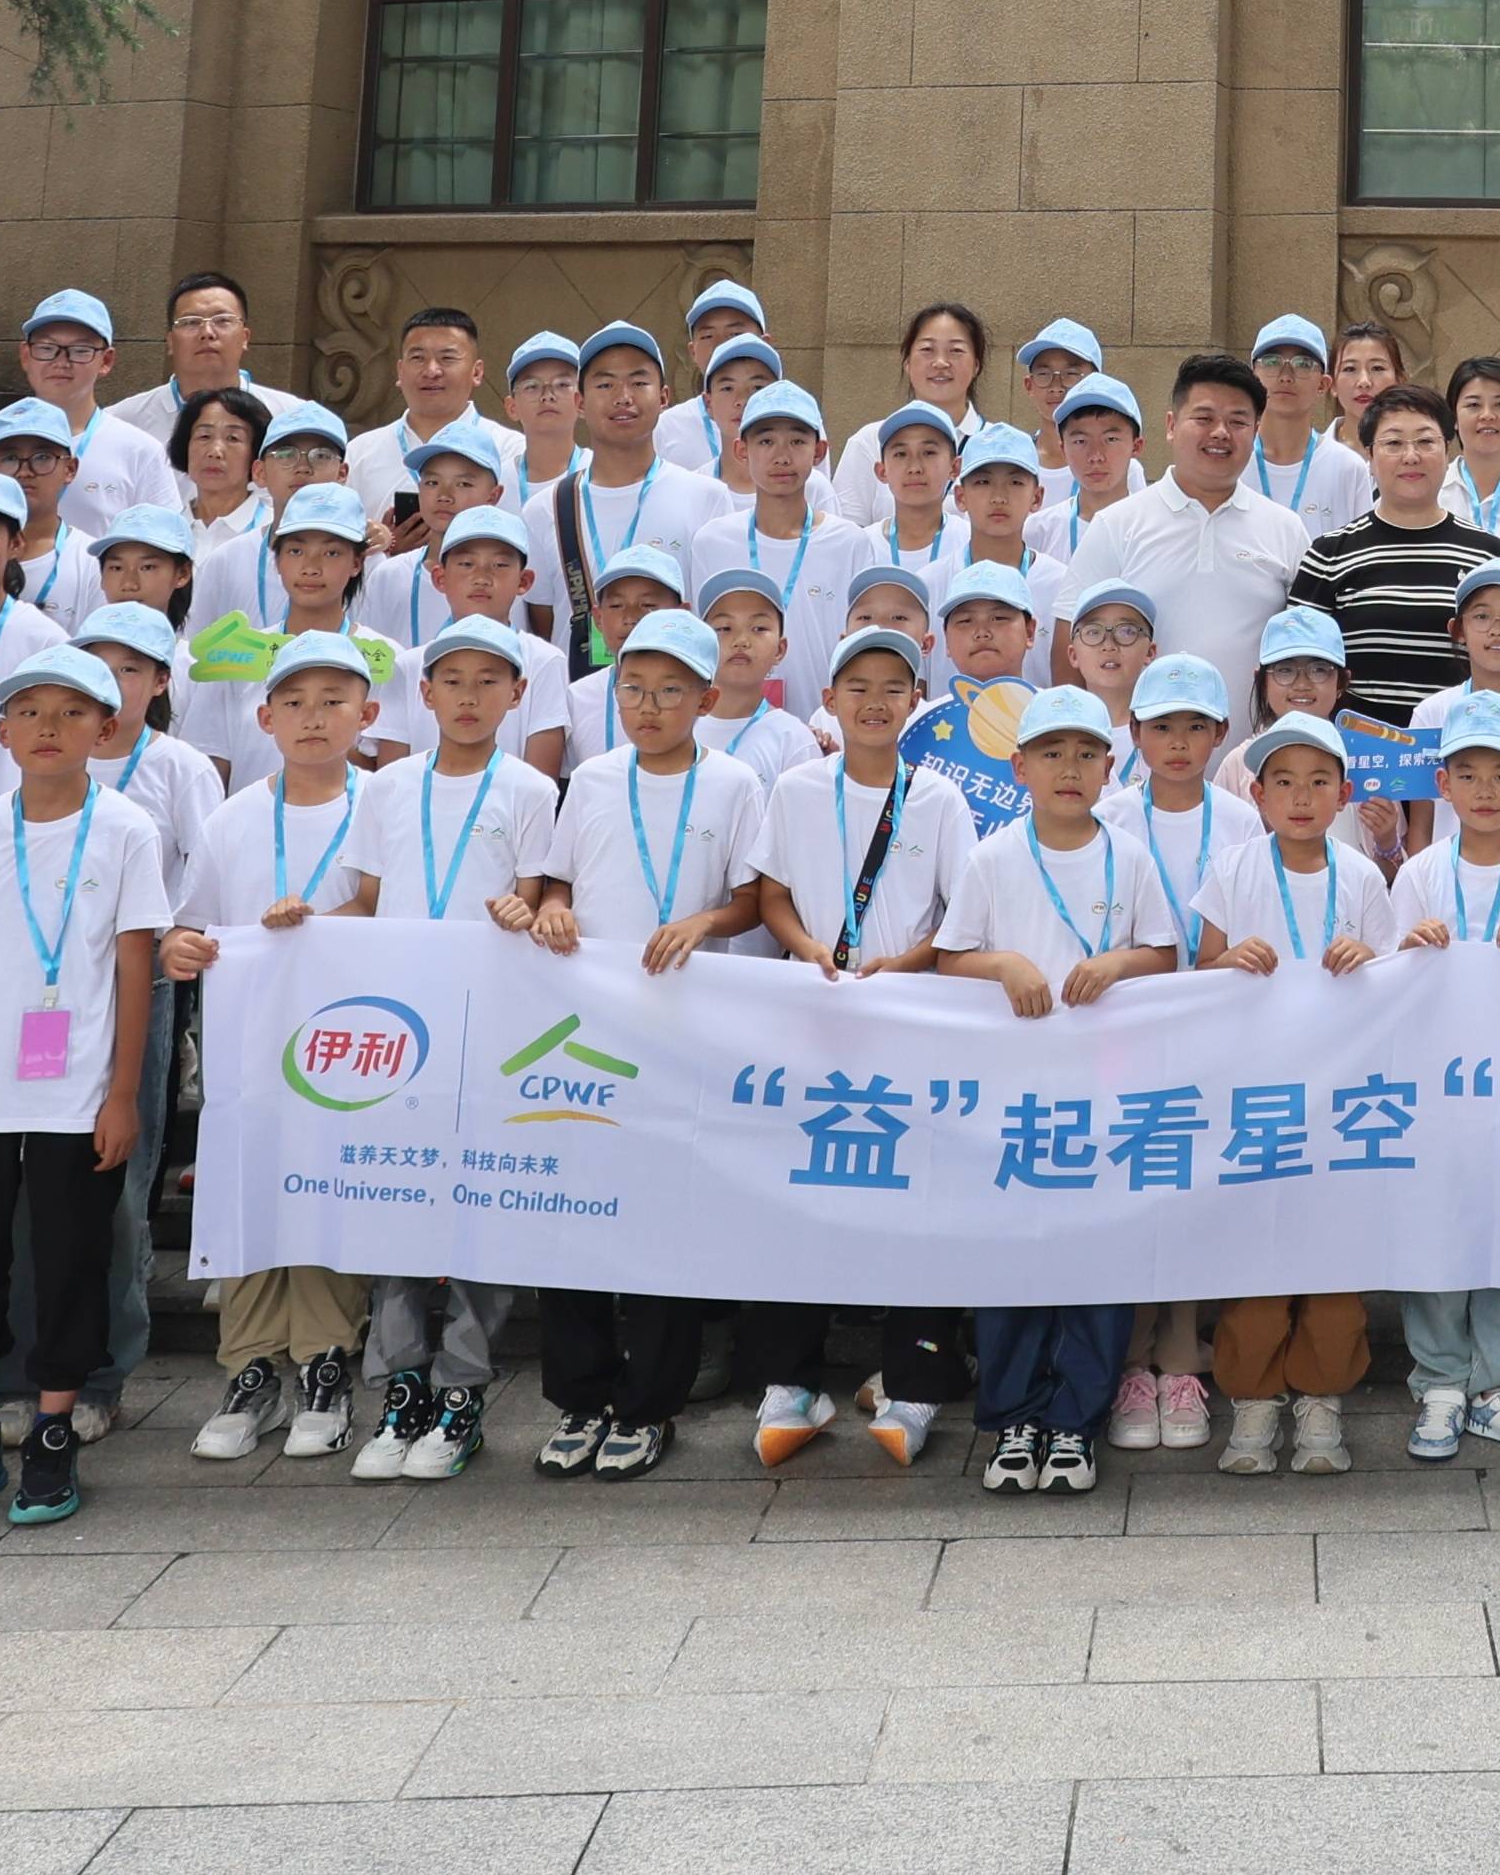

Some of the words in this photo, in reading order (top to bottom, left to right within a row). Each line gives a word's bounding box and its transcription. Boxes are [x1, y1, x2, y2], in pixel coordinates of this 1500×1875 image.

[304, 1029, 407, 1078] 伊利
[519, 1075, 616, 1107] CPWF
[284, 1174, 329, 1195] One
[452, 1184, 492, 1208] One
[499, 1189, 618, 1217] Childhood
